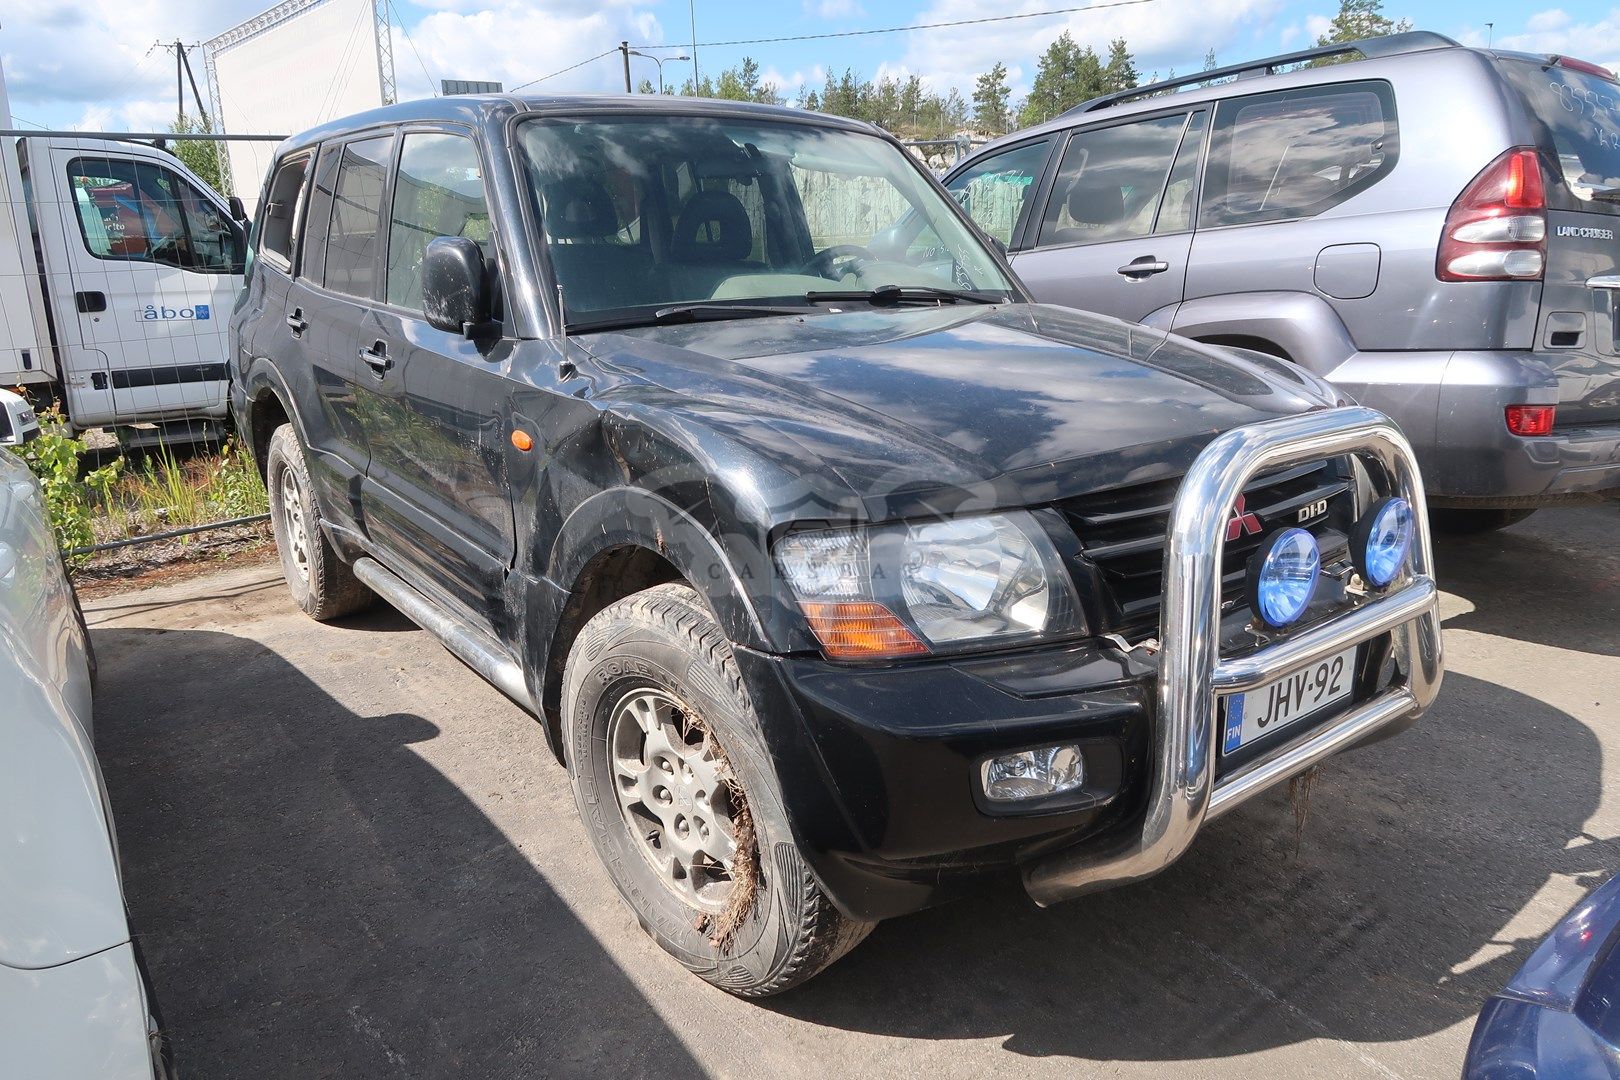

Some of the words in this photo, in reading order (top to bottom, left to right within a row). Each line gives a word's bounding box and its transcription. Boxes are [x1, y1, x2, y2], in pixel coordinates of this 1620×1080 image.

[1556, 226, 1580, 237] LAND
[1580, 227, 1613, 240] CRUISER
[143, 304, 195, 320] åbo
[1257, 655, 1344, 729] JHV-92
[1226, 724, 1242, 742] FIN
